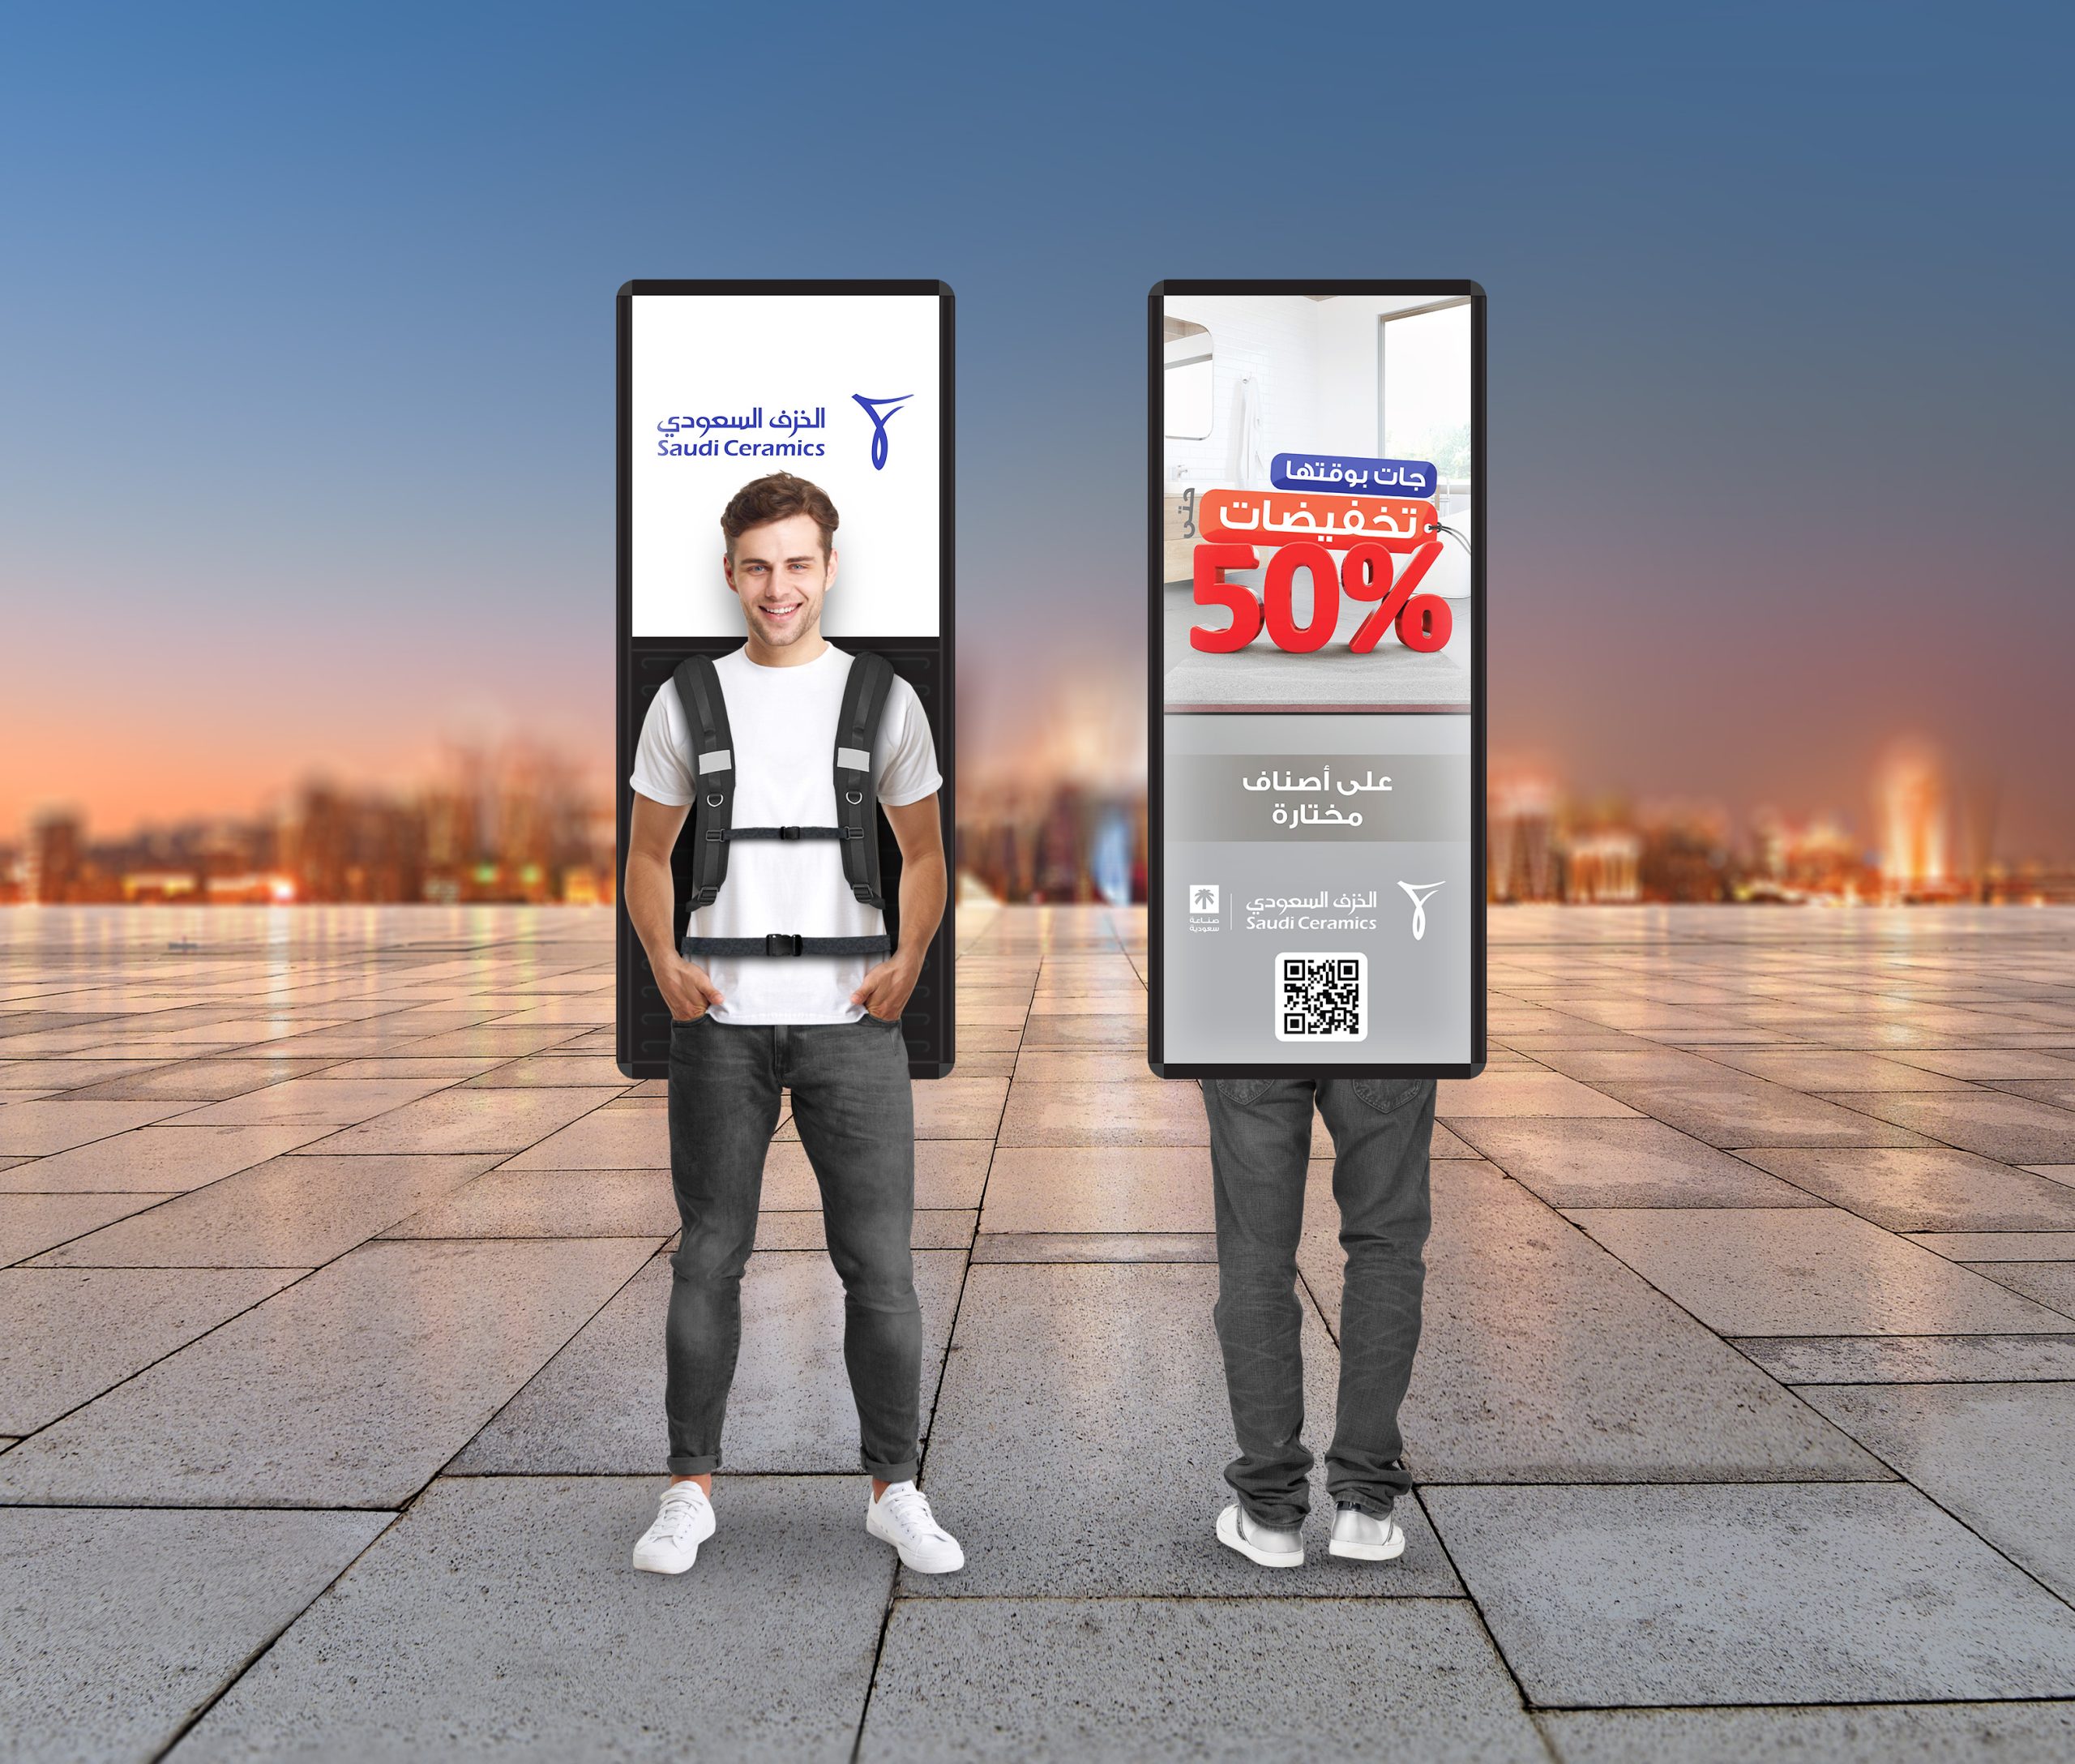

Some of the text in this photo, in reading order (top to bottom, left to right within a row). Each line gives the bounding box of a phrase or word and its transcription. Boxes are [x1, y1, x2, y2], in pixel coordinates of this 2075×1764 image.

[657, 407, 825, 438] الخزف السعودي
[657, 439, 825, 456] Saudi Ceramics
[1286, 460, 1426, 491] جات بوقتها
[1178, 487, 1196, 539] حتى
[1219, 499, 1418, 542] تخفيضات
[1190, 542, 1453, 653] 50%
[1243, 765, 1393, 795] على أصناف
[1272, 803, 1363, 829] مختارة
[1246, 891, 1377, 915] الخزف السعودي
[1189, 916, 1220, 924] صناعة
[1189, 924, 1220, 933] سعودية
[1246, 916, 1377, 930] Saudi Ceramics
